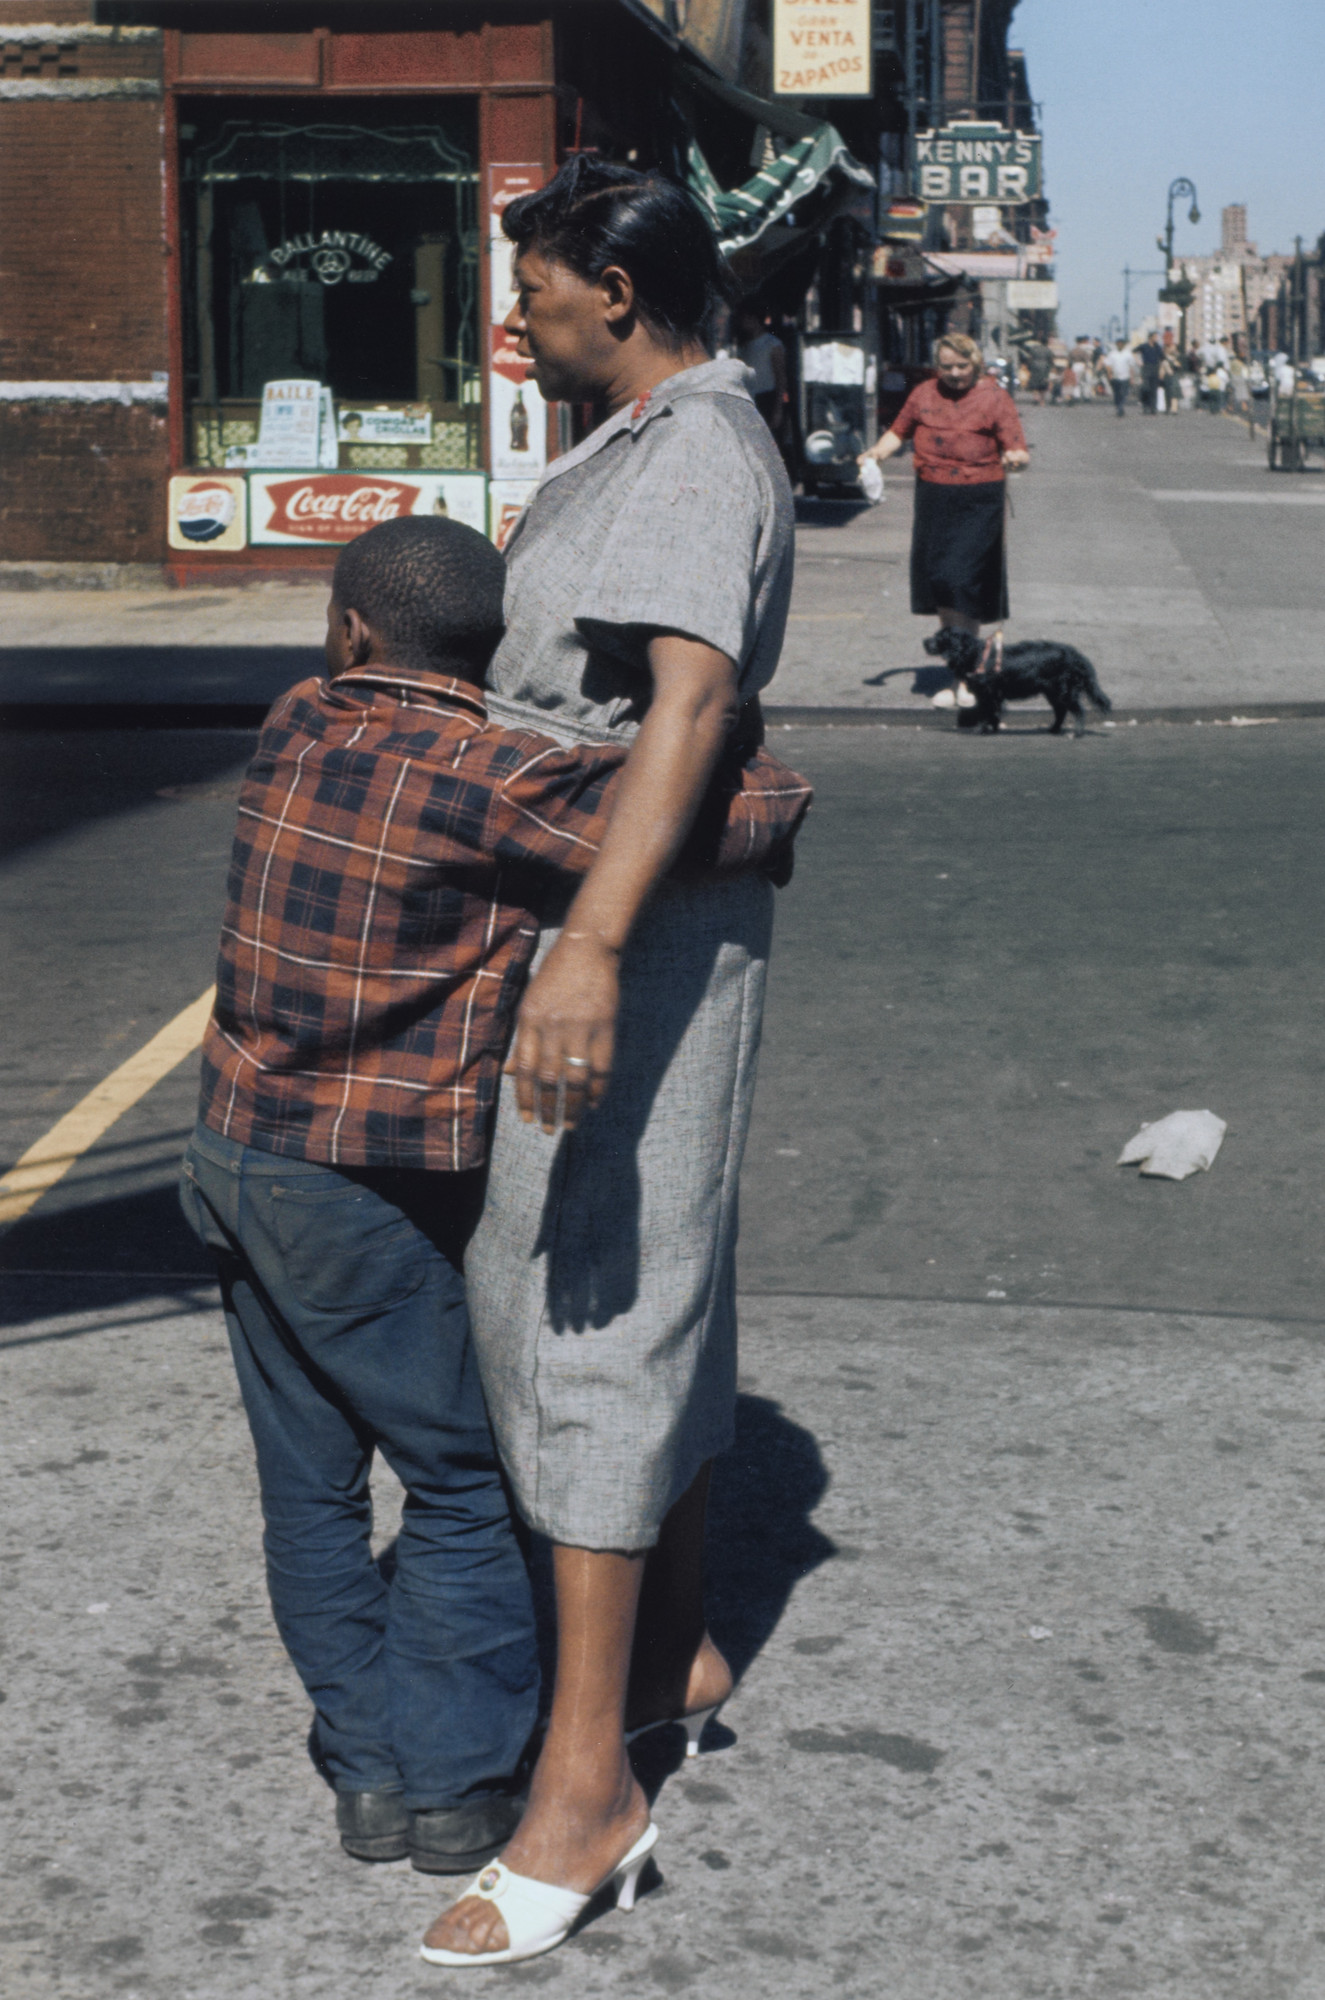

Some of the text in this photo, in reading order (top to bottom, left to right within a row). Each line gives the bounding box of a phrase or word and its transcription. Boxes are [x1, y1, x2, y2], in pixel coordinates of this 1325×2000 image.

[790, 30, 855, 46] VENTA
[780, 56, 862, 88] ZAPATOS
[921, 165, 1029, 201] BAR
[270, 230, 393, 270] BALLANTINE
[266, 386, 314, 401] BAILE
[285, 486, 404, 521] Coca-Cola
